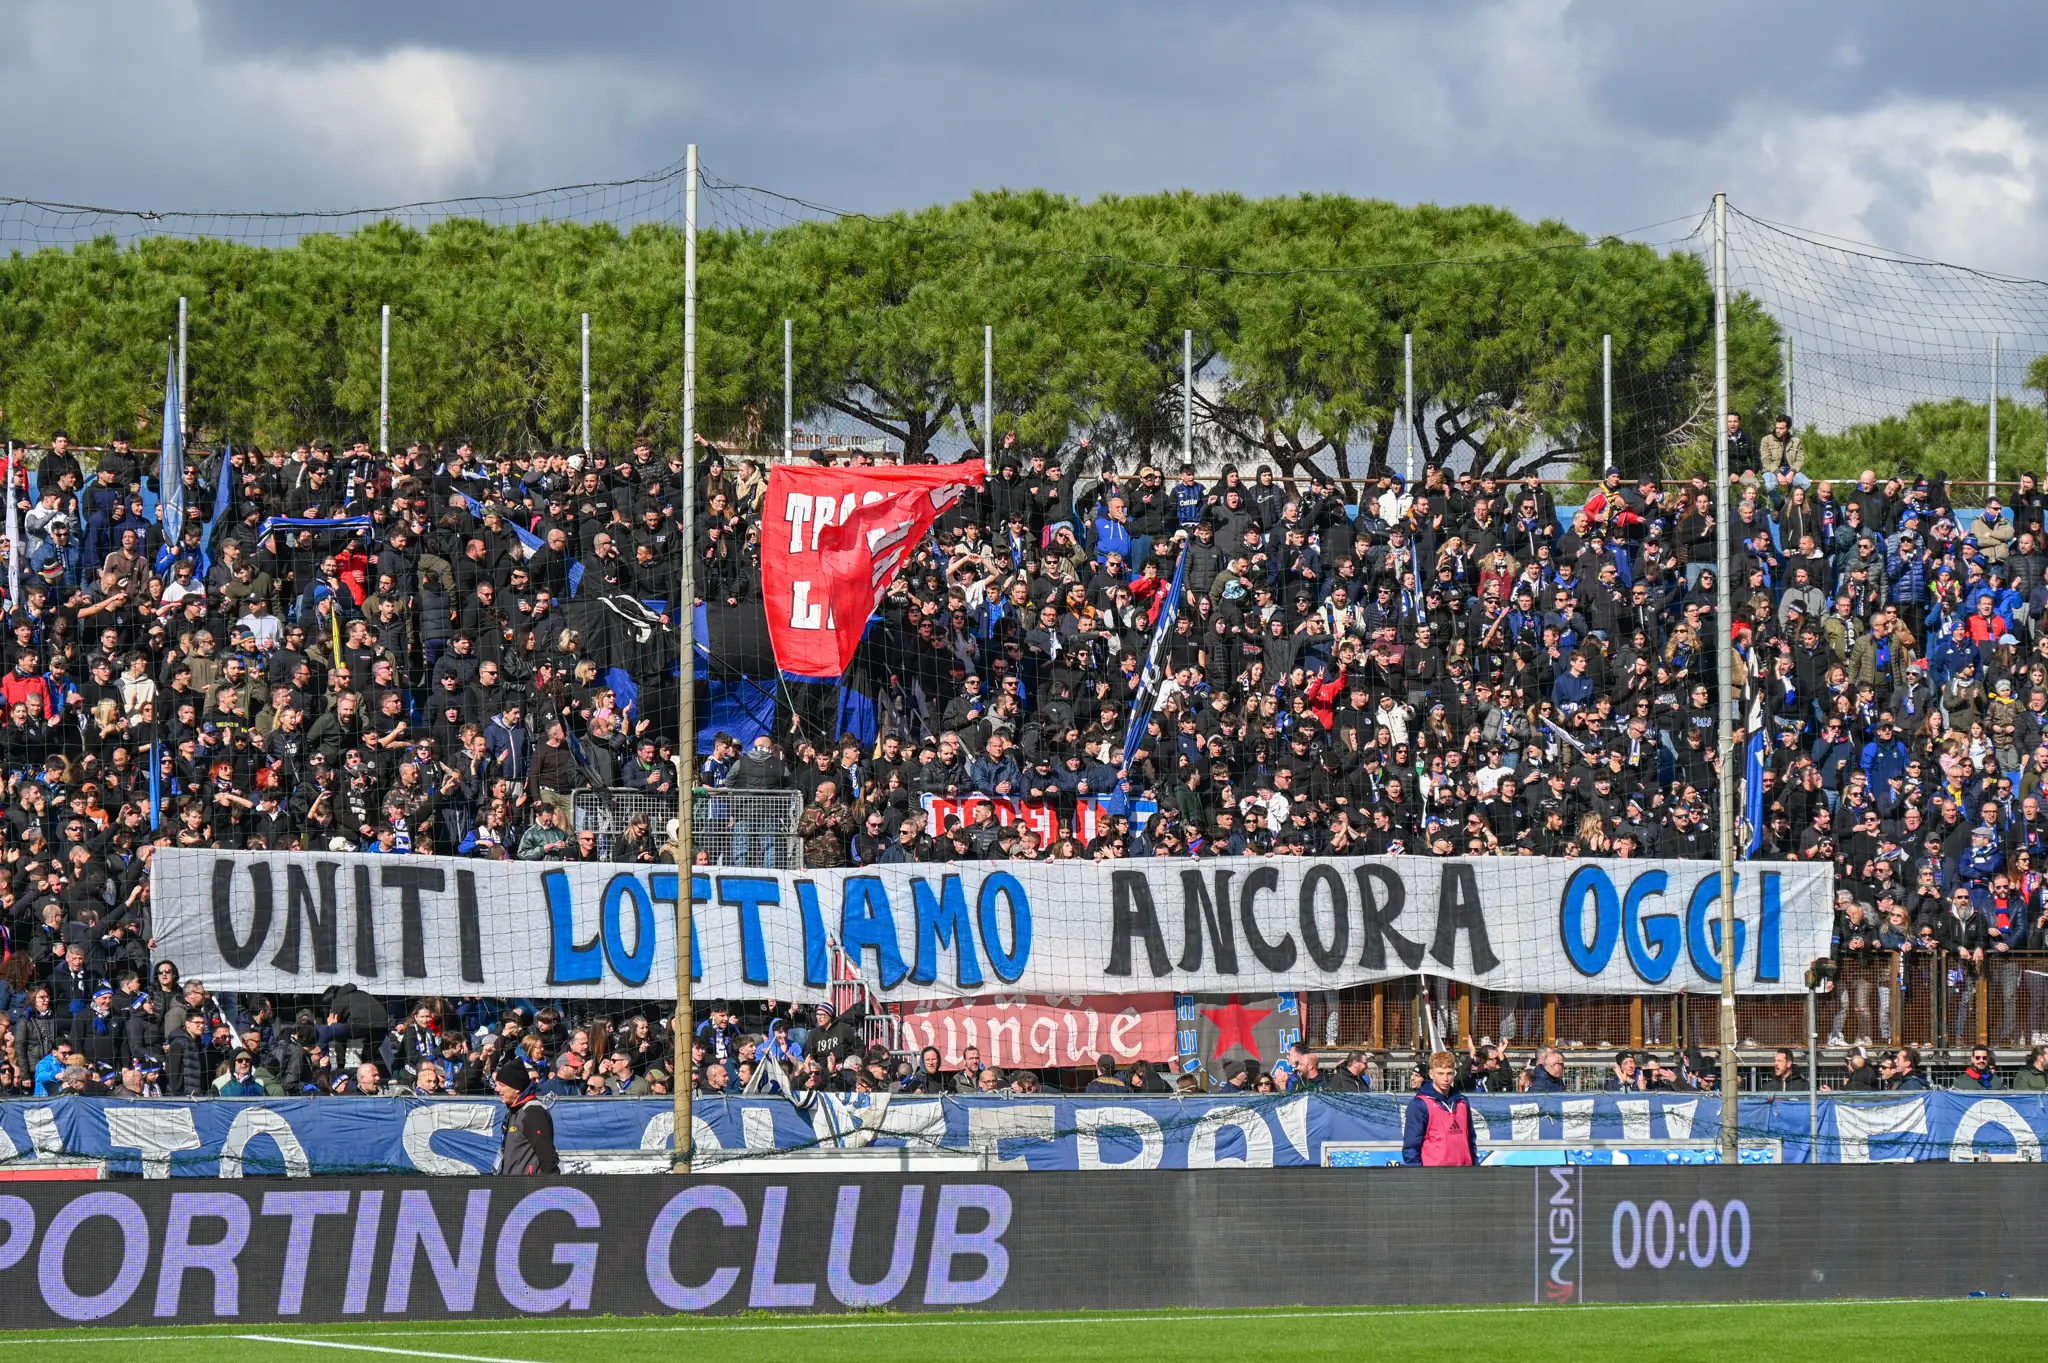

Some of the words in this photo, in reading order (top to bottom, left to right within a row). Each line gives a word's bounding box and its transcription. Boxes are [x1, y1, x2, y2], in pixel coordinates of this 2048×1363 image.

[212, 859, 484, 983] UNITI
[540, 867, 1032, 992] LOTTIAMO
[1104, 862, 1500, 978] ANCORA
[1559, 863, 1782, 985] OGGI
[817, 1036, 839, 1052] 1978
[647, 1184, 1013, 1310] CLUB
[1549, 1167, 1575, 1285] NGM
[1612, 1199, 1751, 1269] 00:00
